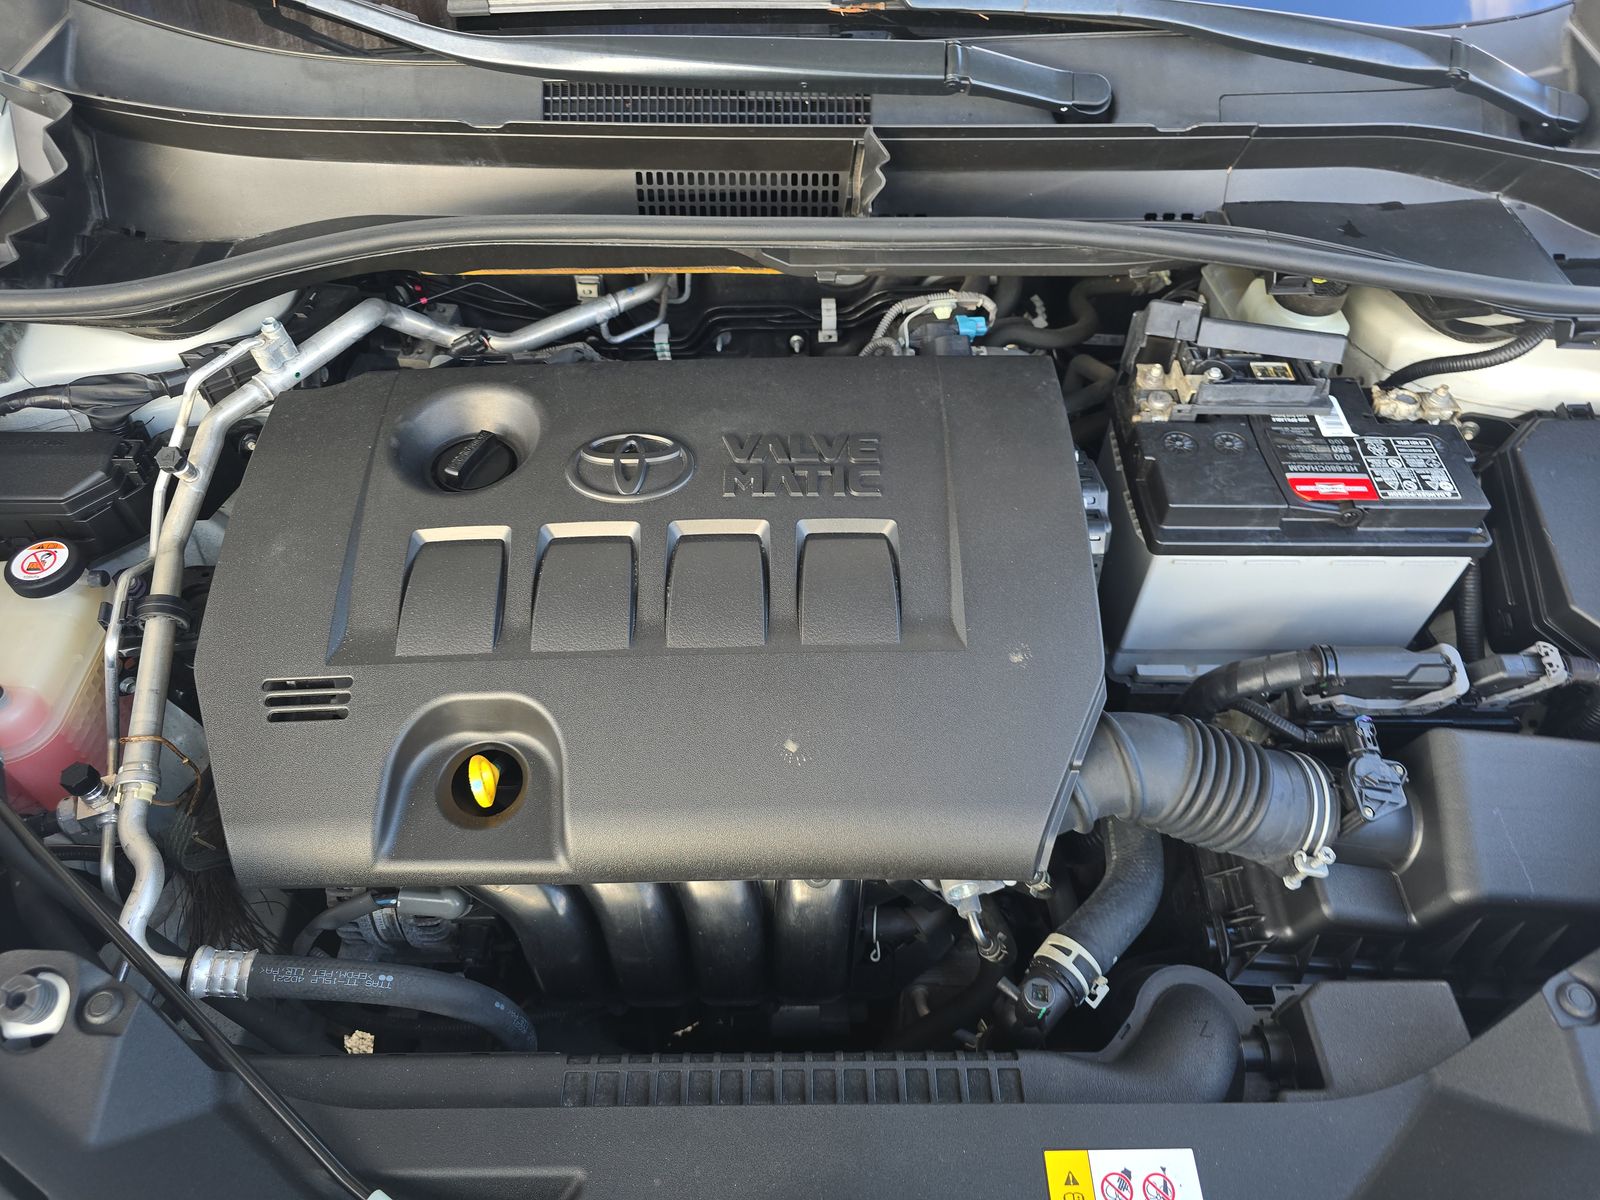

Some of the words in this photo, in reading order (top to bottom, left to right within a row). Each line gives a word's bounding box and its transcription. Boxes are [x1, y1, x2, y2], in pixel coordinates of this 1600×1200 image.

[721, 433, 882, 464] VALVE
[1330, 445, 1351, 454] 850
[1333, 453, 1354, 462] 680
[722, 464, 882, 497] MATIC
